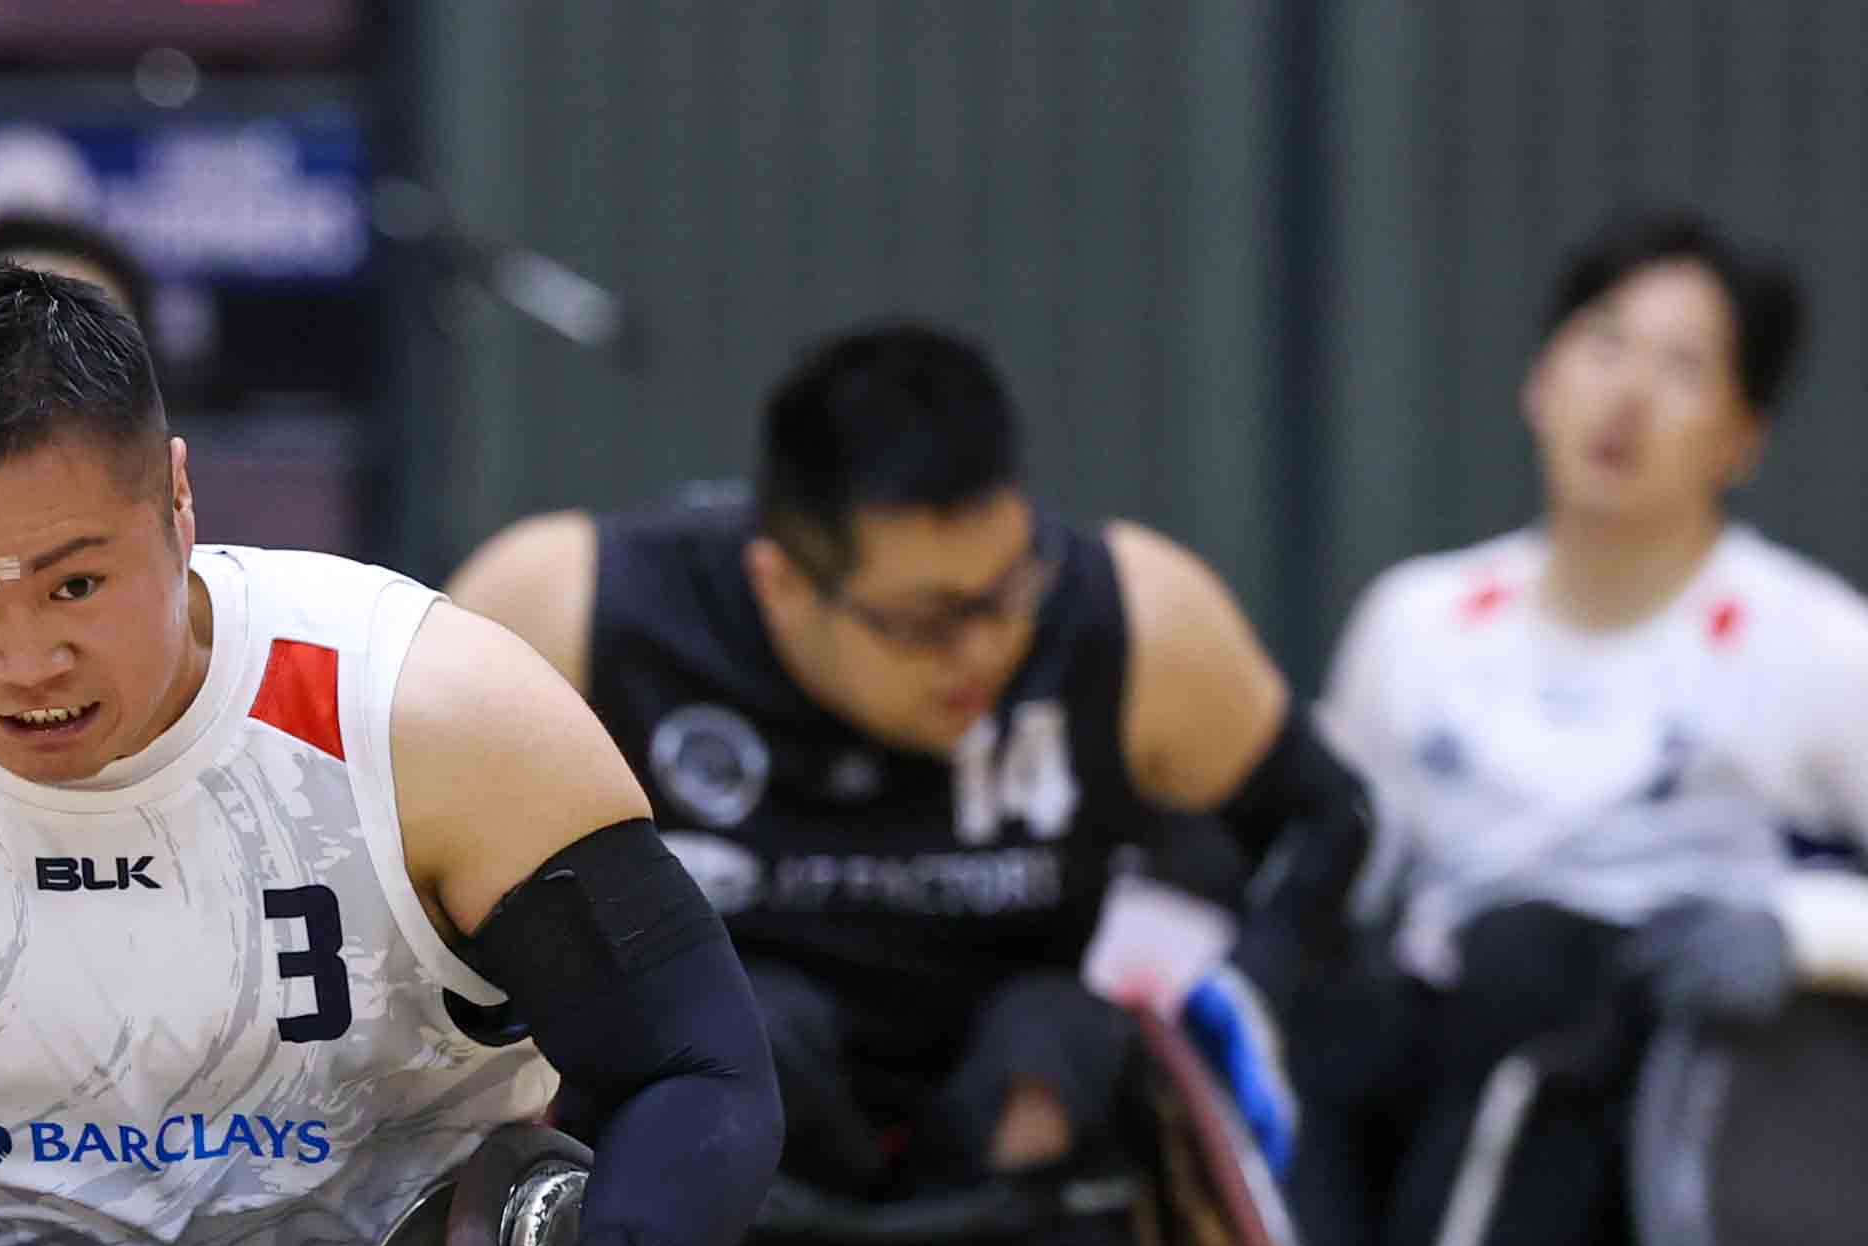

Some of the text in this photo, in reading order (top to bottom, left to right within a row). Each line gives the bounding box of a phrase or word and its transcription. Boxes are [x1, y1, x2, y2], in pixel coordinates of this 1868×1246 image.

[35, 856, 161, 891] BLK
[263, 884, 352, 1043] 3
[29, 1113, 331, 1172] BARCLAYS
